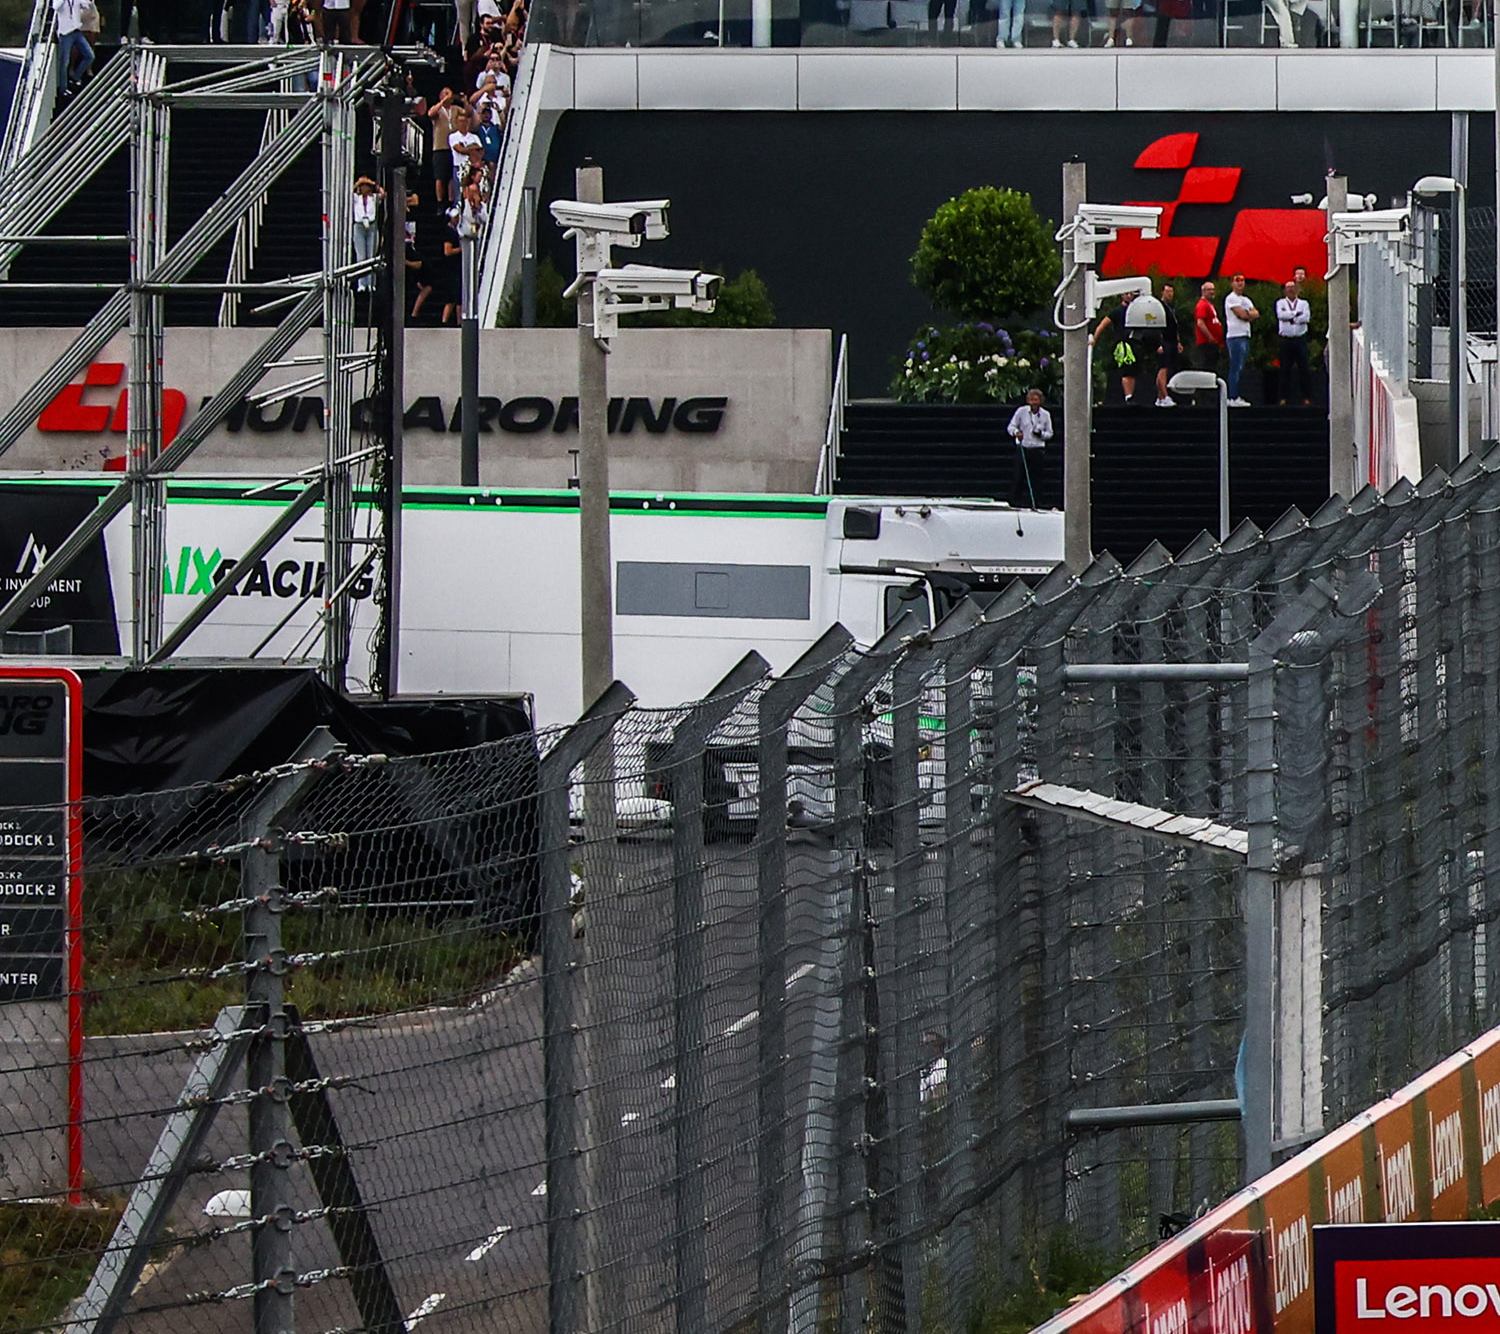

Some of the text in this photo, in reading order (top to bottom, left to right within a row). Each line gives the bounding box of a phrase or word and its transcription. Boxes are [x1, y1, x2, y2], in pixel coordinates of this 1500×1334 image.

[47, 834, 55, 846] 1
[47, 884, 56, 896] 2
[1429, 1109, 1464, 1199] Lenovo
[1269, 1213, 1310, 1314] Lenovo
